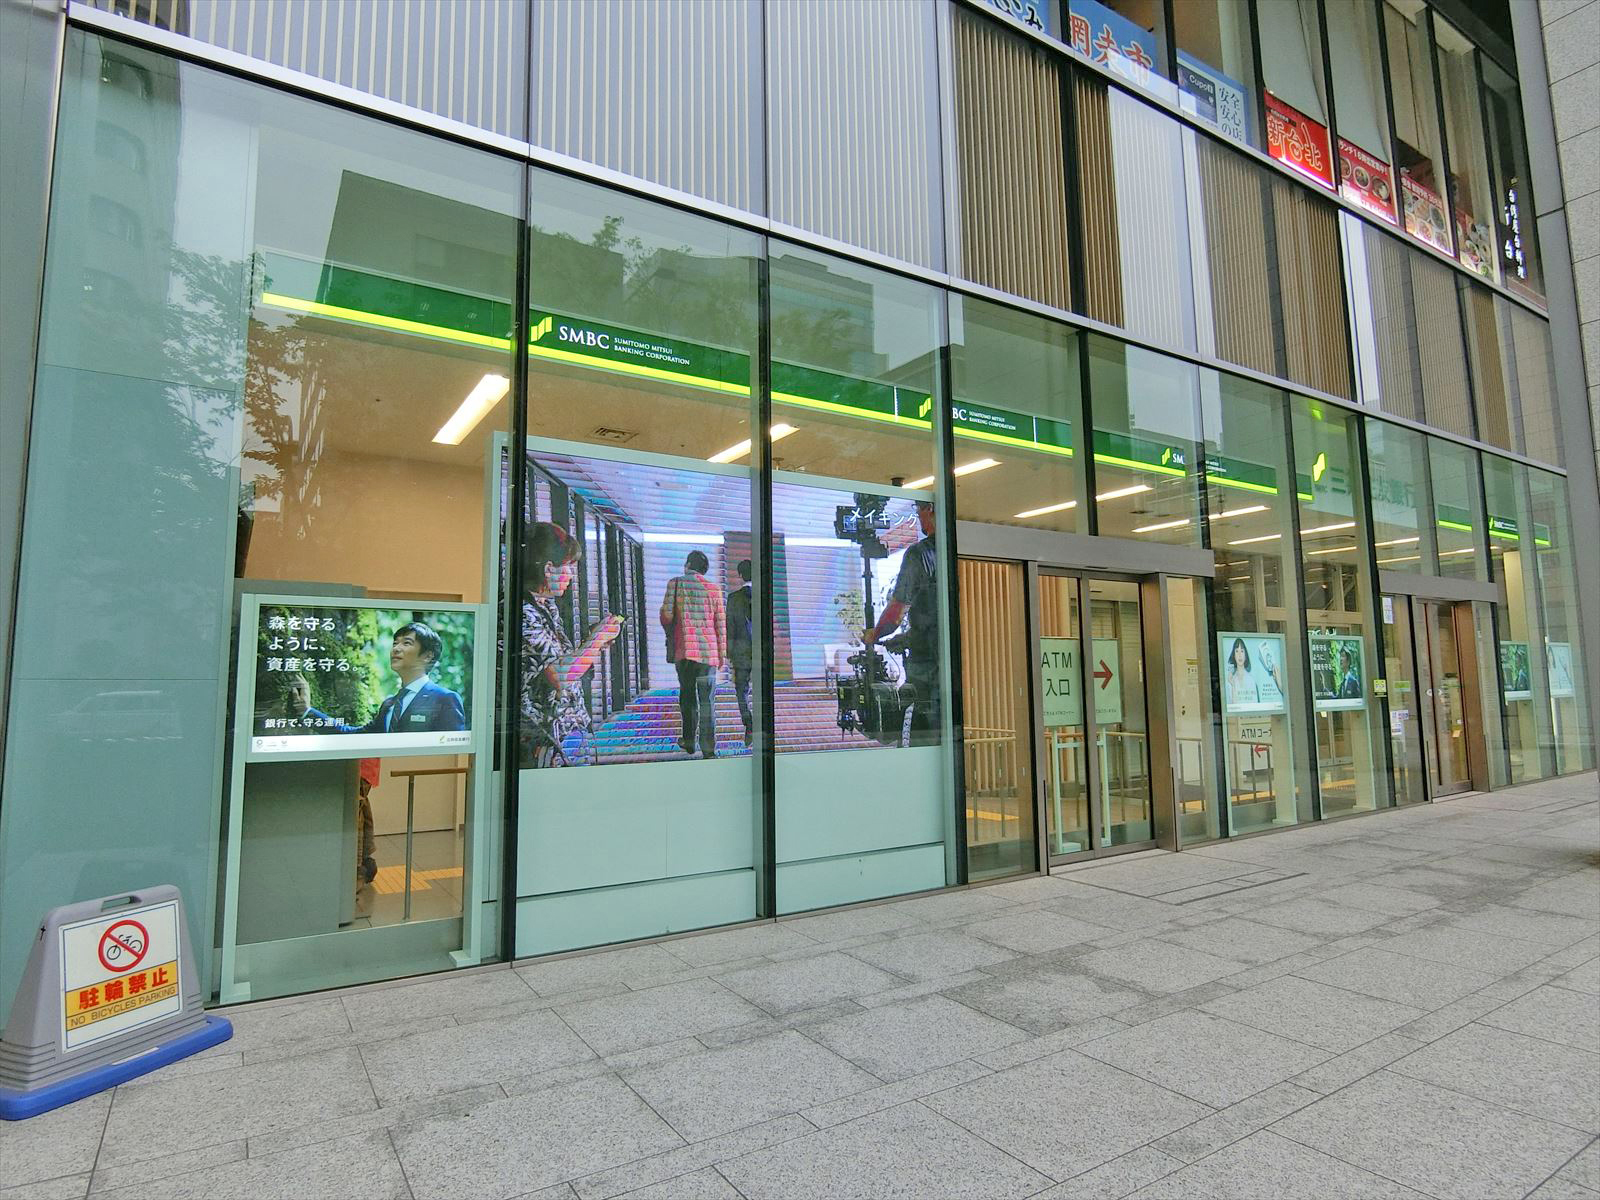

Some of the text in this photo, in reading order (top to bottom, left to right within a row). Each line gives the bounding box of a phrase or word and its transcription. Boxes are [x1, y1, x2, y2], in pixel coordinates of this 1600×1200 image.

[1266, 115, 1324, 172] 新台北
[558, 325, 610, 350] SMBC
[614, 337, 673, 355] SUMITOMO MITSUI
[614, 345, 690, 366] BANKING CORPORATION
[951, 407, 967, 421] BC
[850, 507, 919, 529] メイキング
[268, 616, 336, 631] 森を守る
[268, 636, 326, 651] ように、
[266, 656, 359, 672] 資産を守る。
[1041, 652, 1073, 668] ATM
[1045, 678, 1071, 697] 入口
[79, 967, 169, 1010] 駐輪禁止
[70, 986, 176, 1027] NO BICYCLES PARKING
